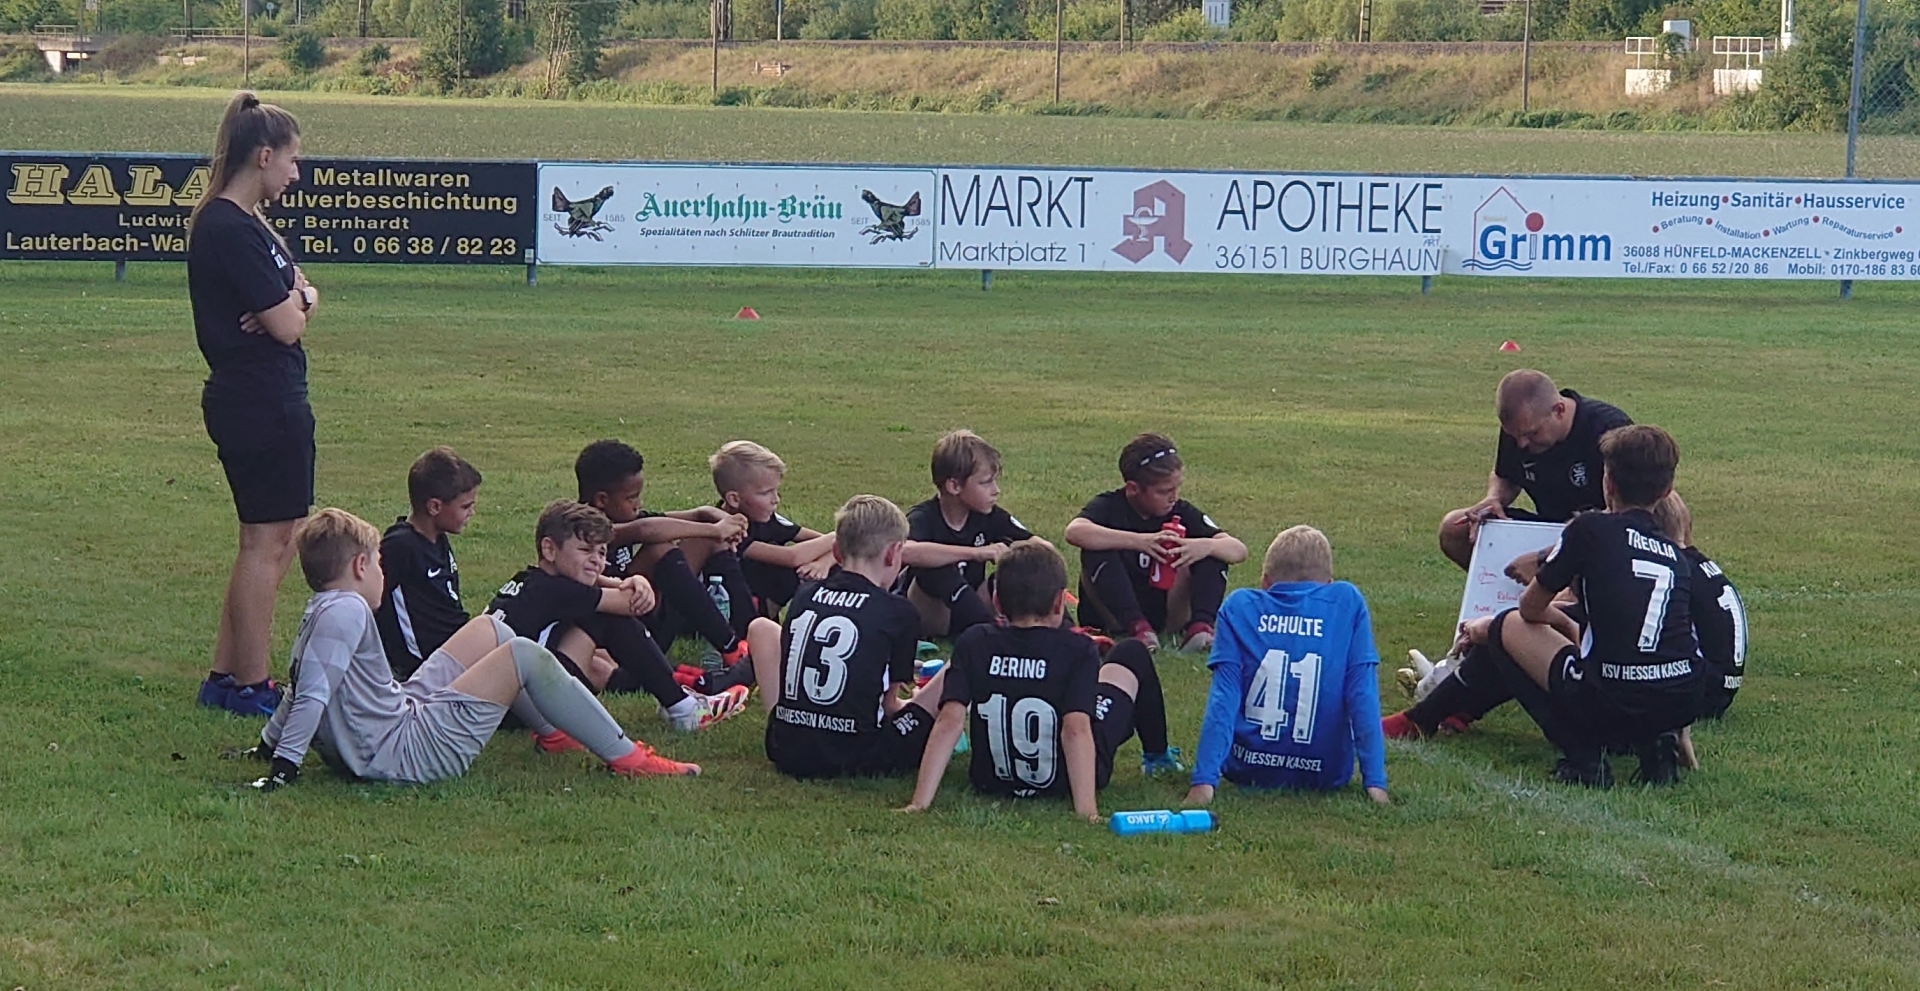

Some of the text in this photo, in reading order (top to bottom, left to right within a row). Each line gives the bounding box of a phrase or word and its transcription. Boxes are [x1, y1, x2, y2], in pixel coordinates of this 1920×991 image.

[313, 168, 470, 188] Metallwaren
[264, 190, 518, 214] ulverbeschichtung
[635, 191, 843, 225] Auerhahn-Bräu
[941, 174, 1094, 228] MARKT
[1216, 179, 1443, 234] APOTHEKE
[1651, 191, 1906, 211] Heizung Sanitär Hausservice
[119, 213, 192, 229] Ludwig
[304, 215, 410, 230] Bernhardt
[543, 213, 561, 222] SEIT
[851, 217, 869, 225] SEIT
[1660, 214, 1894, 240] Beratung Installation Wartung Reparaturservice
[639, 227, 835, 238] Spezialitäten nach Schlitzer Brautradition
[1479, 212, 1612, 261] Grimm
[300, 235, 339, 254] Tel.
[353, 237, 367, 254] 0
[374, 237, 400, 254] 66
[407, 237, 434, 255] 38
[456, 237, 483, 255] 82
[490, 238, 517, 256] 23
[940, 241, 1086, 266] Marktplatz 1
[1623, 245, 1661, 258] 36088
[1664, 243, 1822, 259] HÜNFELD-MACKENZELL
[1833, 247, 1914, 263] Zinkbergweg
[1215, 245, 1441, 271] 36151 BURGHAUN
[1623, 262, 1675, 274] Tel./Fax:
[1787, 263, 1826, 275] Mobil:
[1830, 263, 1886, 276] 0170-186
[1890, 264, 1905, 275] 83
[1626, 528, 1678, 562] TREGLIA
[811, 586, 870, 609] KNAUT
[1632, 559, 1675, 652] 7
[1257, 614, 1324, 637] SCHULTE
[784, 609, 859, 706] 13
[989, 656, 1047, 679] BERING
[1601, 659, 1692, 680] KSV HESSEN KASSEL
[1245, 648, 1322, 745] 41
[785, 708, 817, 729] HESSEN
[817, 713, 858, 733] KASSEL
[976, 693, 1058, 789] 19
[1243, 750, 1286, 767] HESSEN
[1286, 755, 1323, 772] KASSEL
